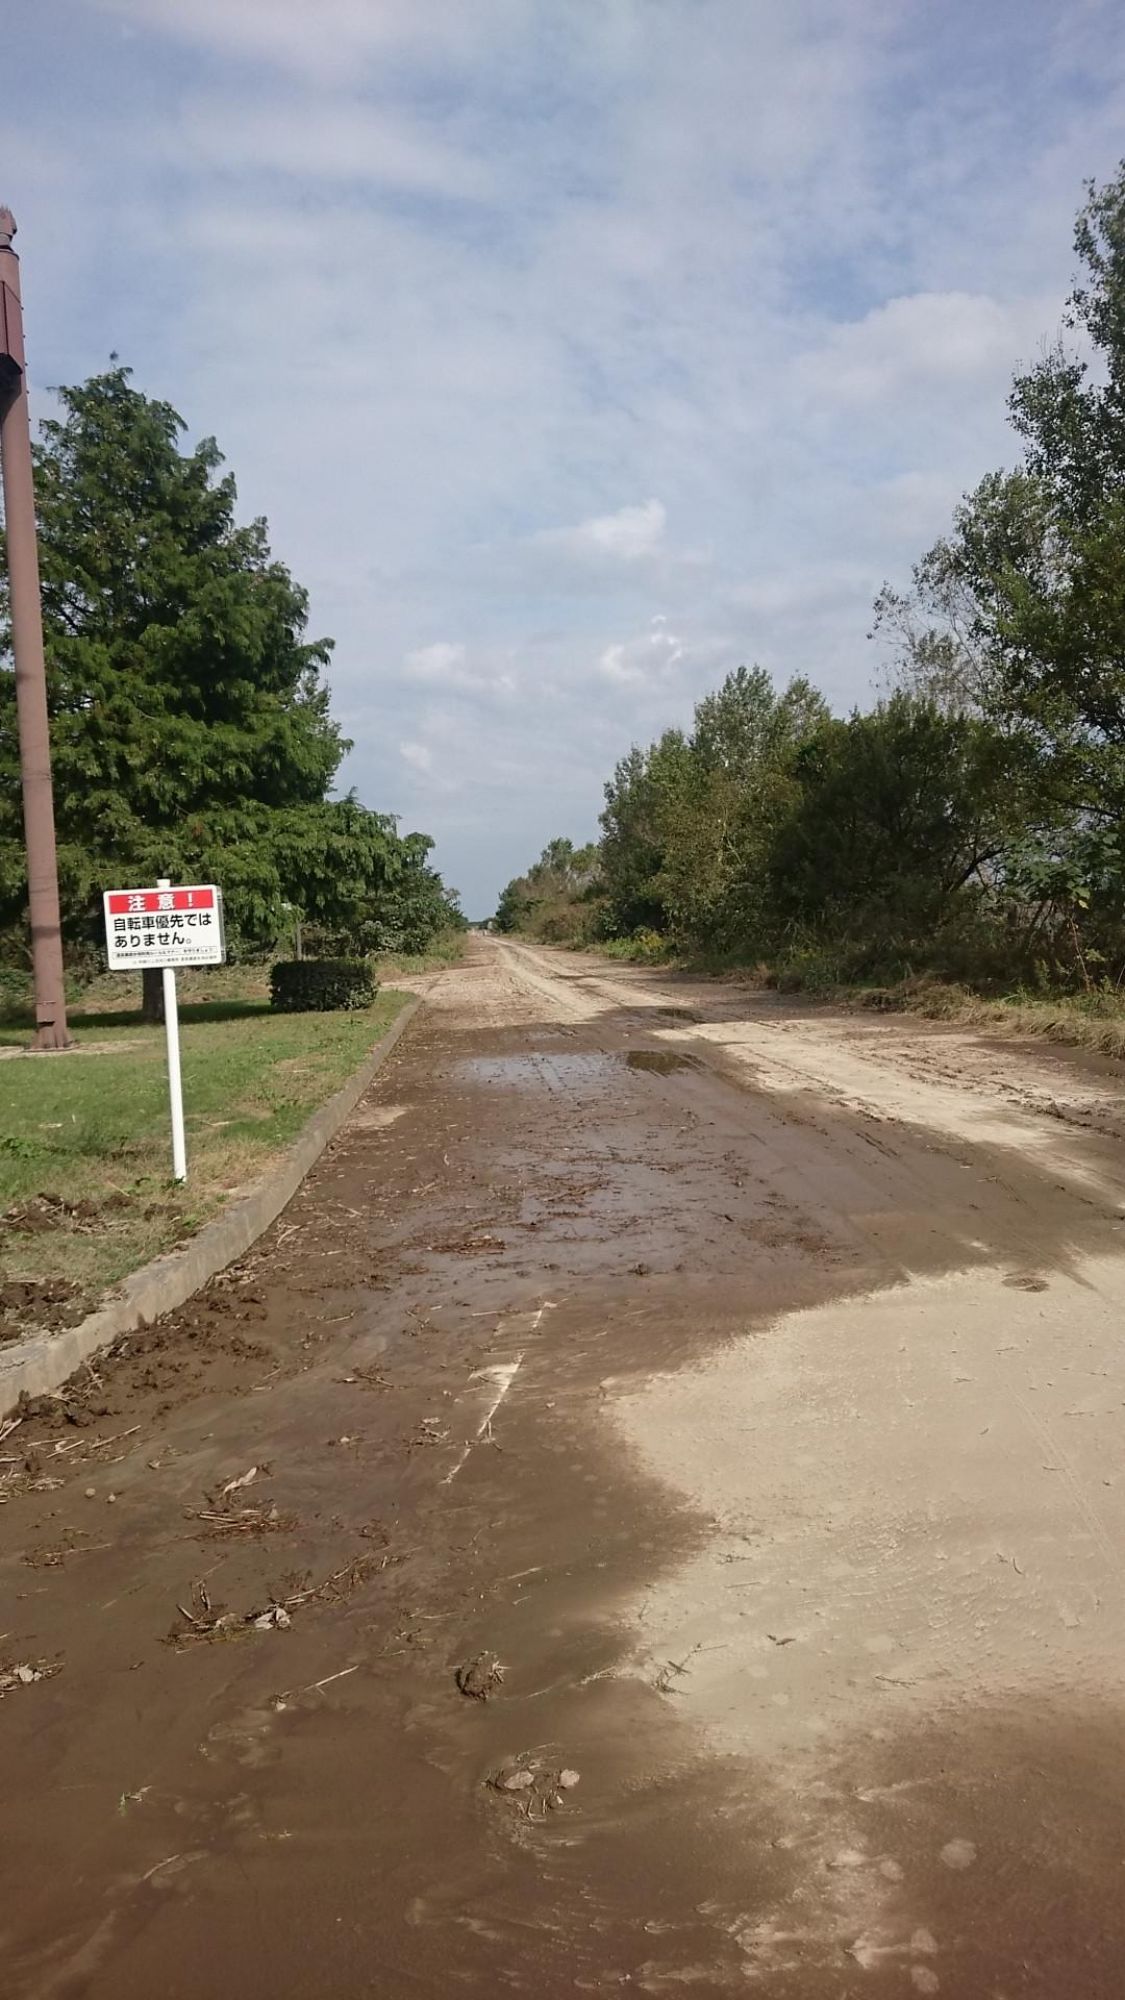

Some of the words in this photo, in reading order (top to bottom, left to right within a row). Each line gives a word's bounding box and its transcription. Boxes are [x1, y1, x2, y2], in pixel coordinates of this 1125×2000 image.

[113, 913, 212, 932] 自転車優先では
[114, 932, 192, 949] ありません。
